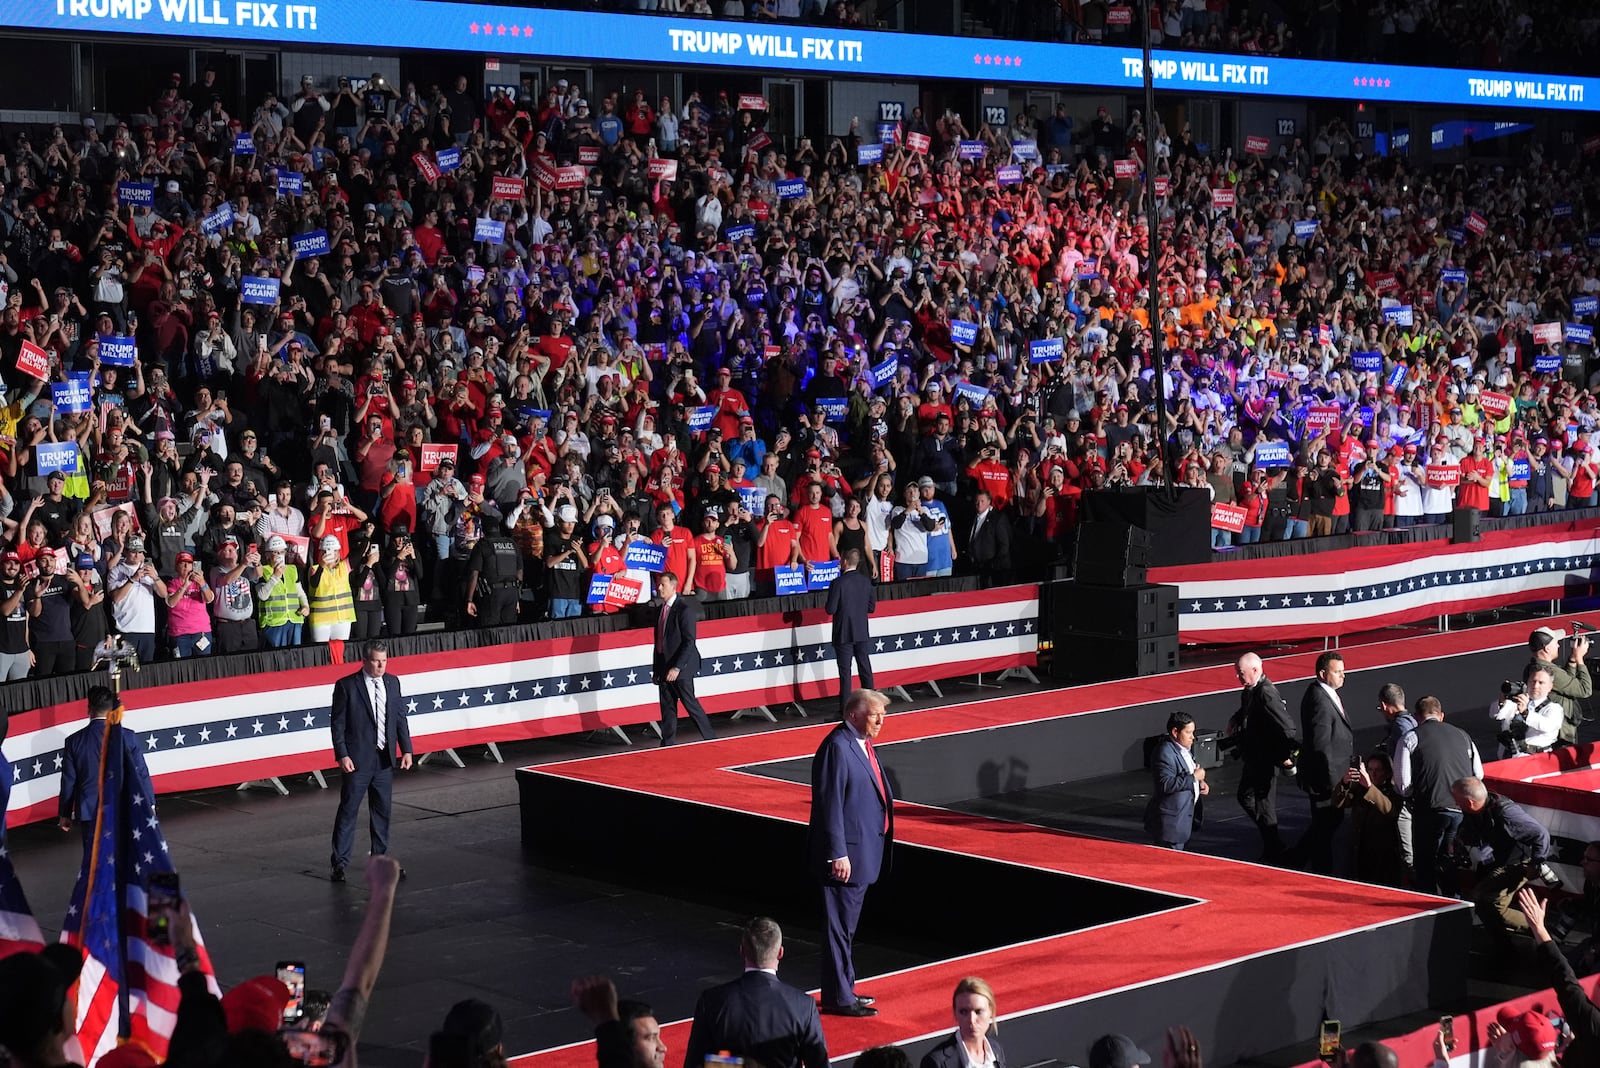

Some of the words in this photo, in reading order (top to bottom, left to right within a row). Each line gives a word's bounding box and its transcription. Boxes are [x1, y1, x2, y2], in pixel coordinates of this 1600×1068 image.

[56, 0, 152, 20] TRUMP
[158, 0, 228, 25] WILL
[236, 3, 279, 29] FIX
[286, 6, 317, 30] IT!
[668, 29, 743, 54] TRUMP
[746, 35, 799, 58] WILL
[802, 38, 834, 61] FIX
[838, 40, 863, 62] IT!
[1122, 57, 1178, 80] TRMP
[1180, 61, 1220, 83] WILL
[1222, 64, 1248, 84] FIX
[1250, 66, 1269, 86] IT!
[1468, 78, 1512, 98] TRUMP
[1514, 81, 1545, 100] WILL
[1547, 84, 1568, 101] FIX
[1569, 85, 1585, 102] IT!
[881, 103, 902, 120] 122
[986, 107, 1005, 124] 123
[1278, 120, 1294, 135] 123
[1358, 123, 1374, 137] 124
[1247, 140, 1268, 149] TRUMP
[120, 187, 151, 197] TRUMP
[494, 187, 520, 195] AGAIN!
[777, 183, 803, 192] TRUMP
[477, 229, 501, 238] AGAIN!
[294, 236, 326, 249] TRUMP
[245, 287, 275, 298] AGAIN!
[1574, 301, 1597, 310] TRUMP
[1385, 310, 1411, 319] TRUMP
[952, 325, 976, 337] TRUMP
[1567, 331, 1590, 340] AGAIN!
[101, 342, 133, 352] TRUMP
[1032, 343, 1062, 355] TRUMP
[22, 348, 47, 366] TRUMP
[1353, 357, 1380, 365] TRUMP
[877, 366, 898, 382] AGAIN!
[55, 388, 79, 397] DREAM
[957, 388, 985, 401] TRUMP
[1482, 393, 1496, 401] DREAM
[57, 394, 89, 405] AGAIN!
[1481, 398, 1506, 410] AGAIN!
[689, 417, 712, 426] AGAIN!
[39, 450, 74, 461] TRUMP
[424, 451, 455, 460] TRUMP
[41, 459, 56, 467] WILL
[104, 482, 127, 491] TRUM
[742, 495, 764, 504] UMP
[1215, 509, 1231, 517] DREAM
[1213, 514, 1241, 525] AGAIN!
[494, 542, 515, 550] POLICE
[629, 546, 650, 555] DREAM
[628, 553, 661, 564] AGAIN!
[777, 572, 792, 580] DREAM
[811, 568, 828, 576] DREAM
[779, 577, 802, 587] AGAIN!
[812, 573, 838, 583] AGAIN!
[591, 587, 608, 595] AGA
[609, 590, 623, 598] WILL
[611, 582, 639, 596] TRUMP
